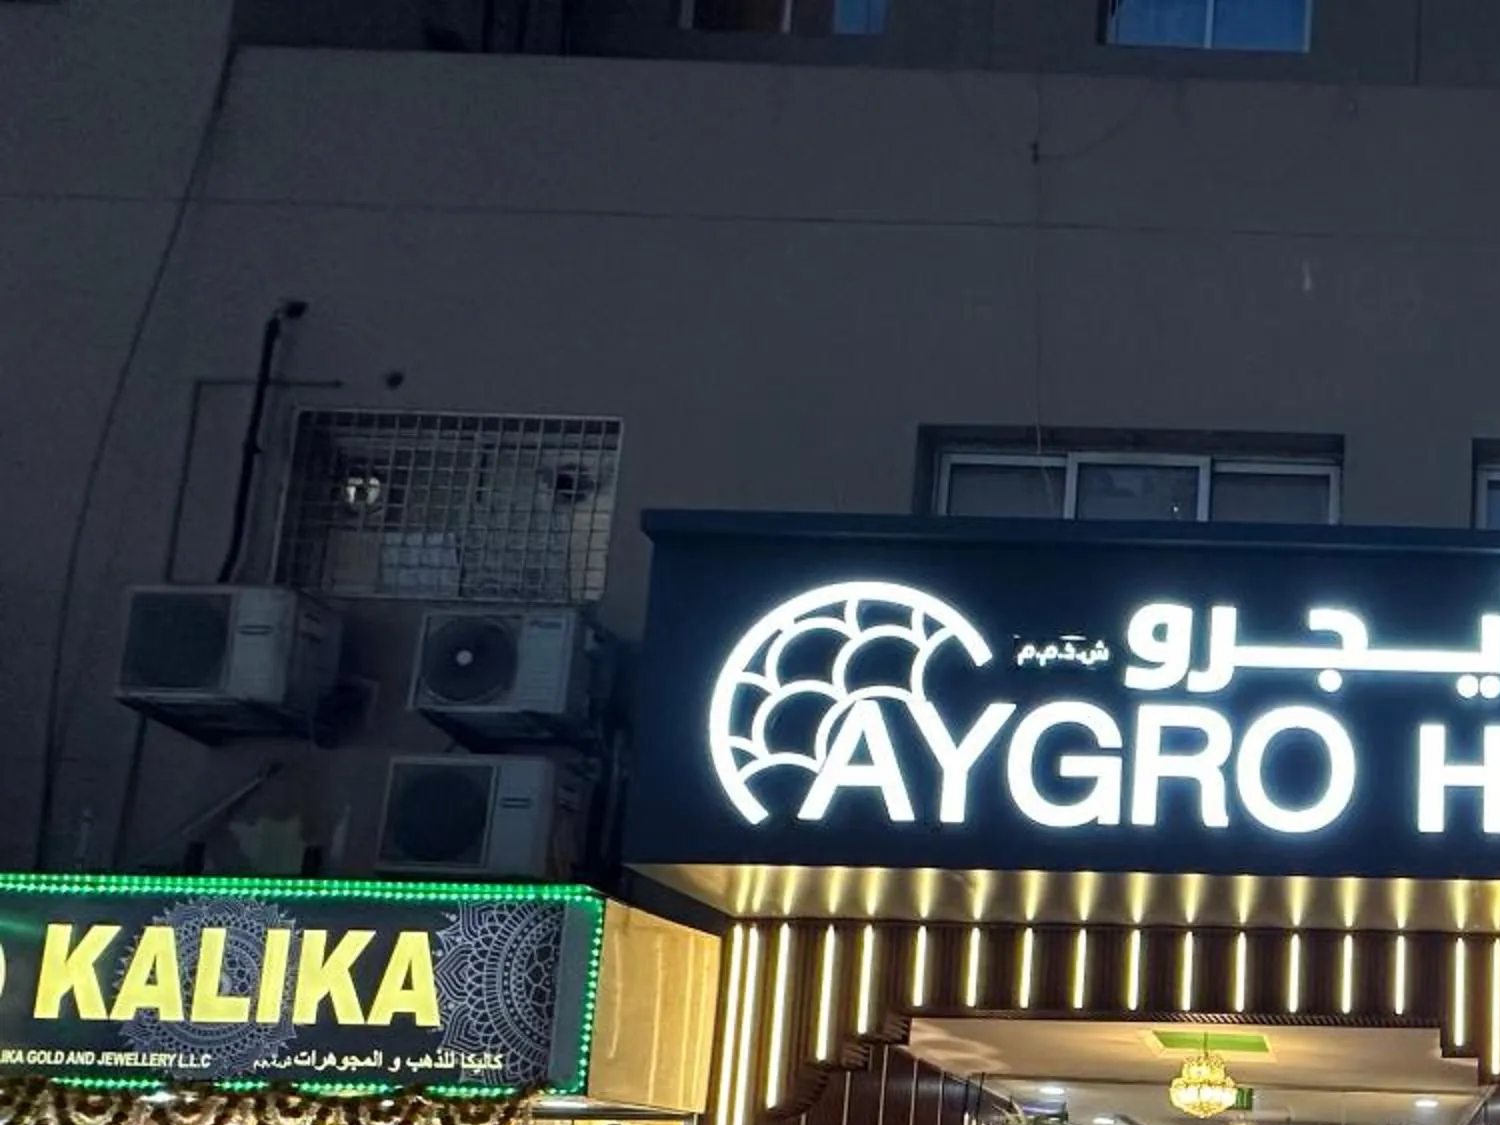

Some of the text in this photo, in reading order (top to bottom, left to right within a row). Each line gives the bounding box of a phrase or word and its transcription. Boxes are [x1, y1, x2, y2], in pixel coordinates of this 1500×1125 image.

[798, 700, 1356, 834] AYGRO
[33, 922, 442, 1028] KALIKA
[26, 1049, 66, 1066] GOLD
[66, 1051, 96, 1066] AND
[97, 1051, 176, 1068] JEWELLERY
[293, 1049, 383, 1073] المجوهرات
[388, 1053, 401, 1072] و
[405, 1048, 455, 1073] للذهب
[461, 1051, 504, 1074] كاليكا
